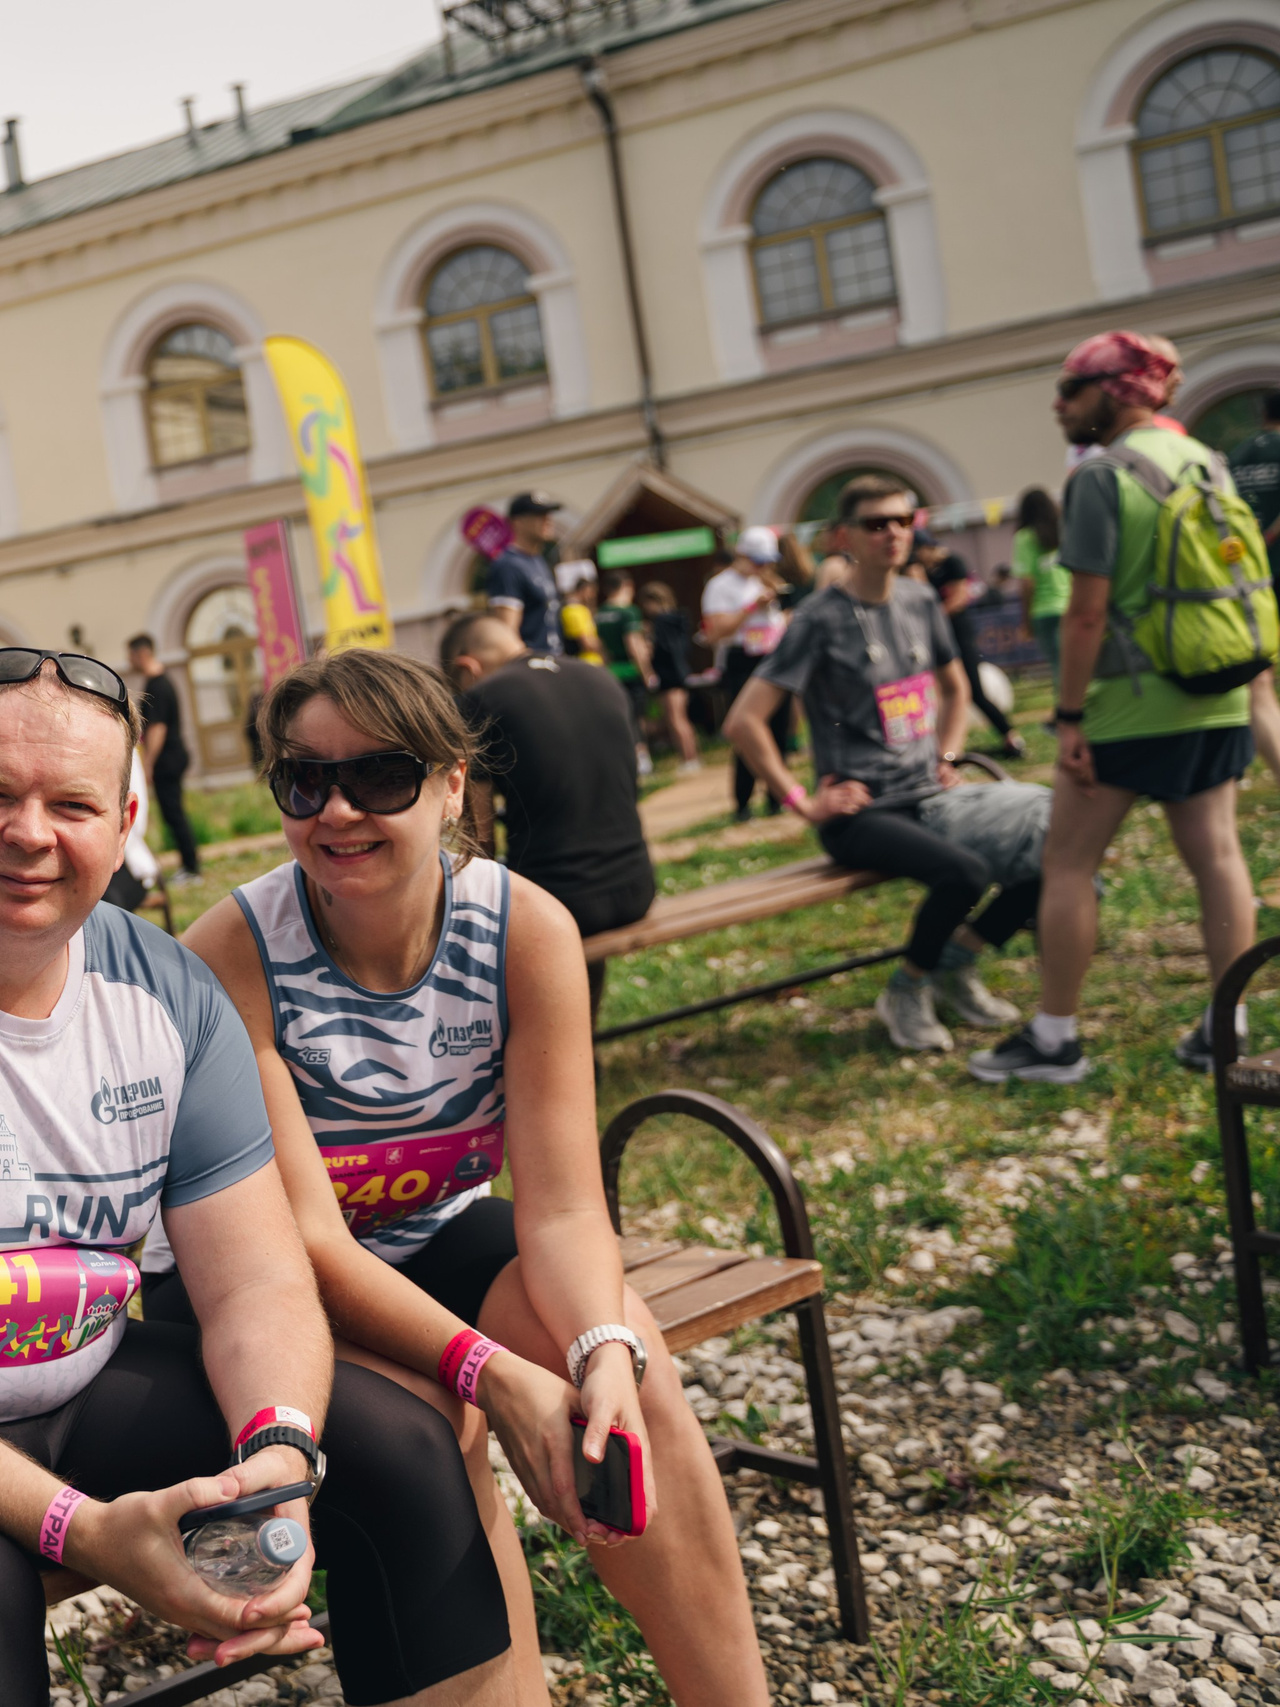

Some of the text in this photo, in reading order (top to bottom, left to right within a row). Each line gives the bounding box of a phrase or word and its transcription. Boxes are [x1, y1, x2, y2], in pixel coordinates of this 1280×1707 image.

[113, 1076, 162, 1105] ГАЗРОМ
[323, 1154, 369, 1168] RUTS
[470, 1156, 479, 1169] 1
[25, 1194, 128, 1240] RUN
